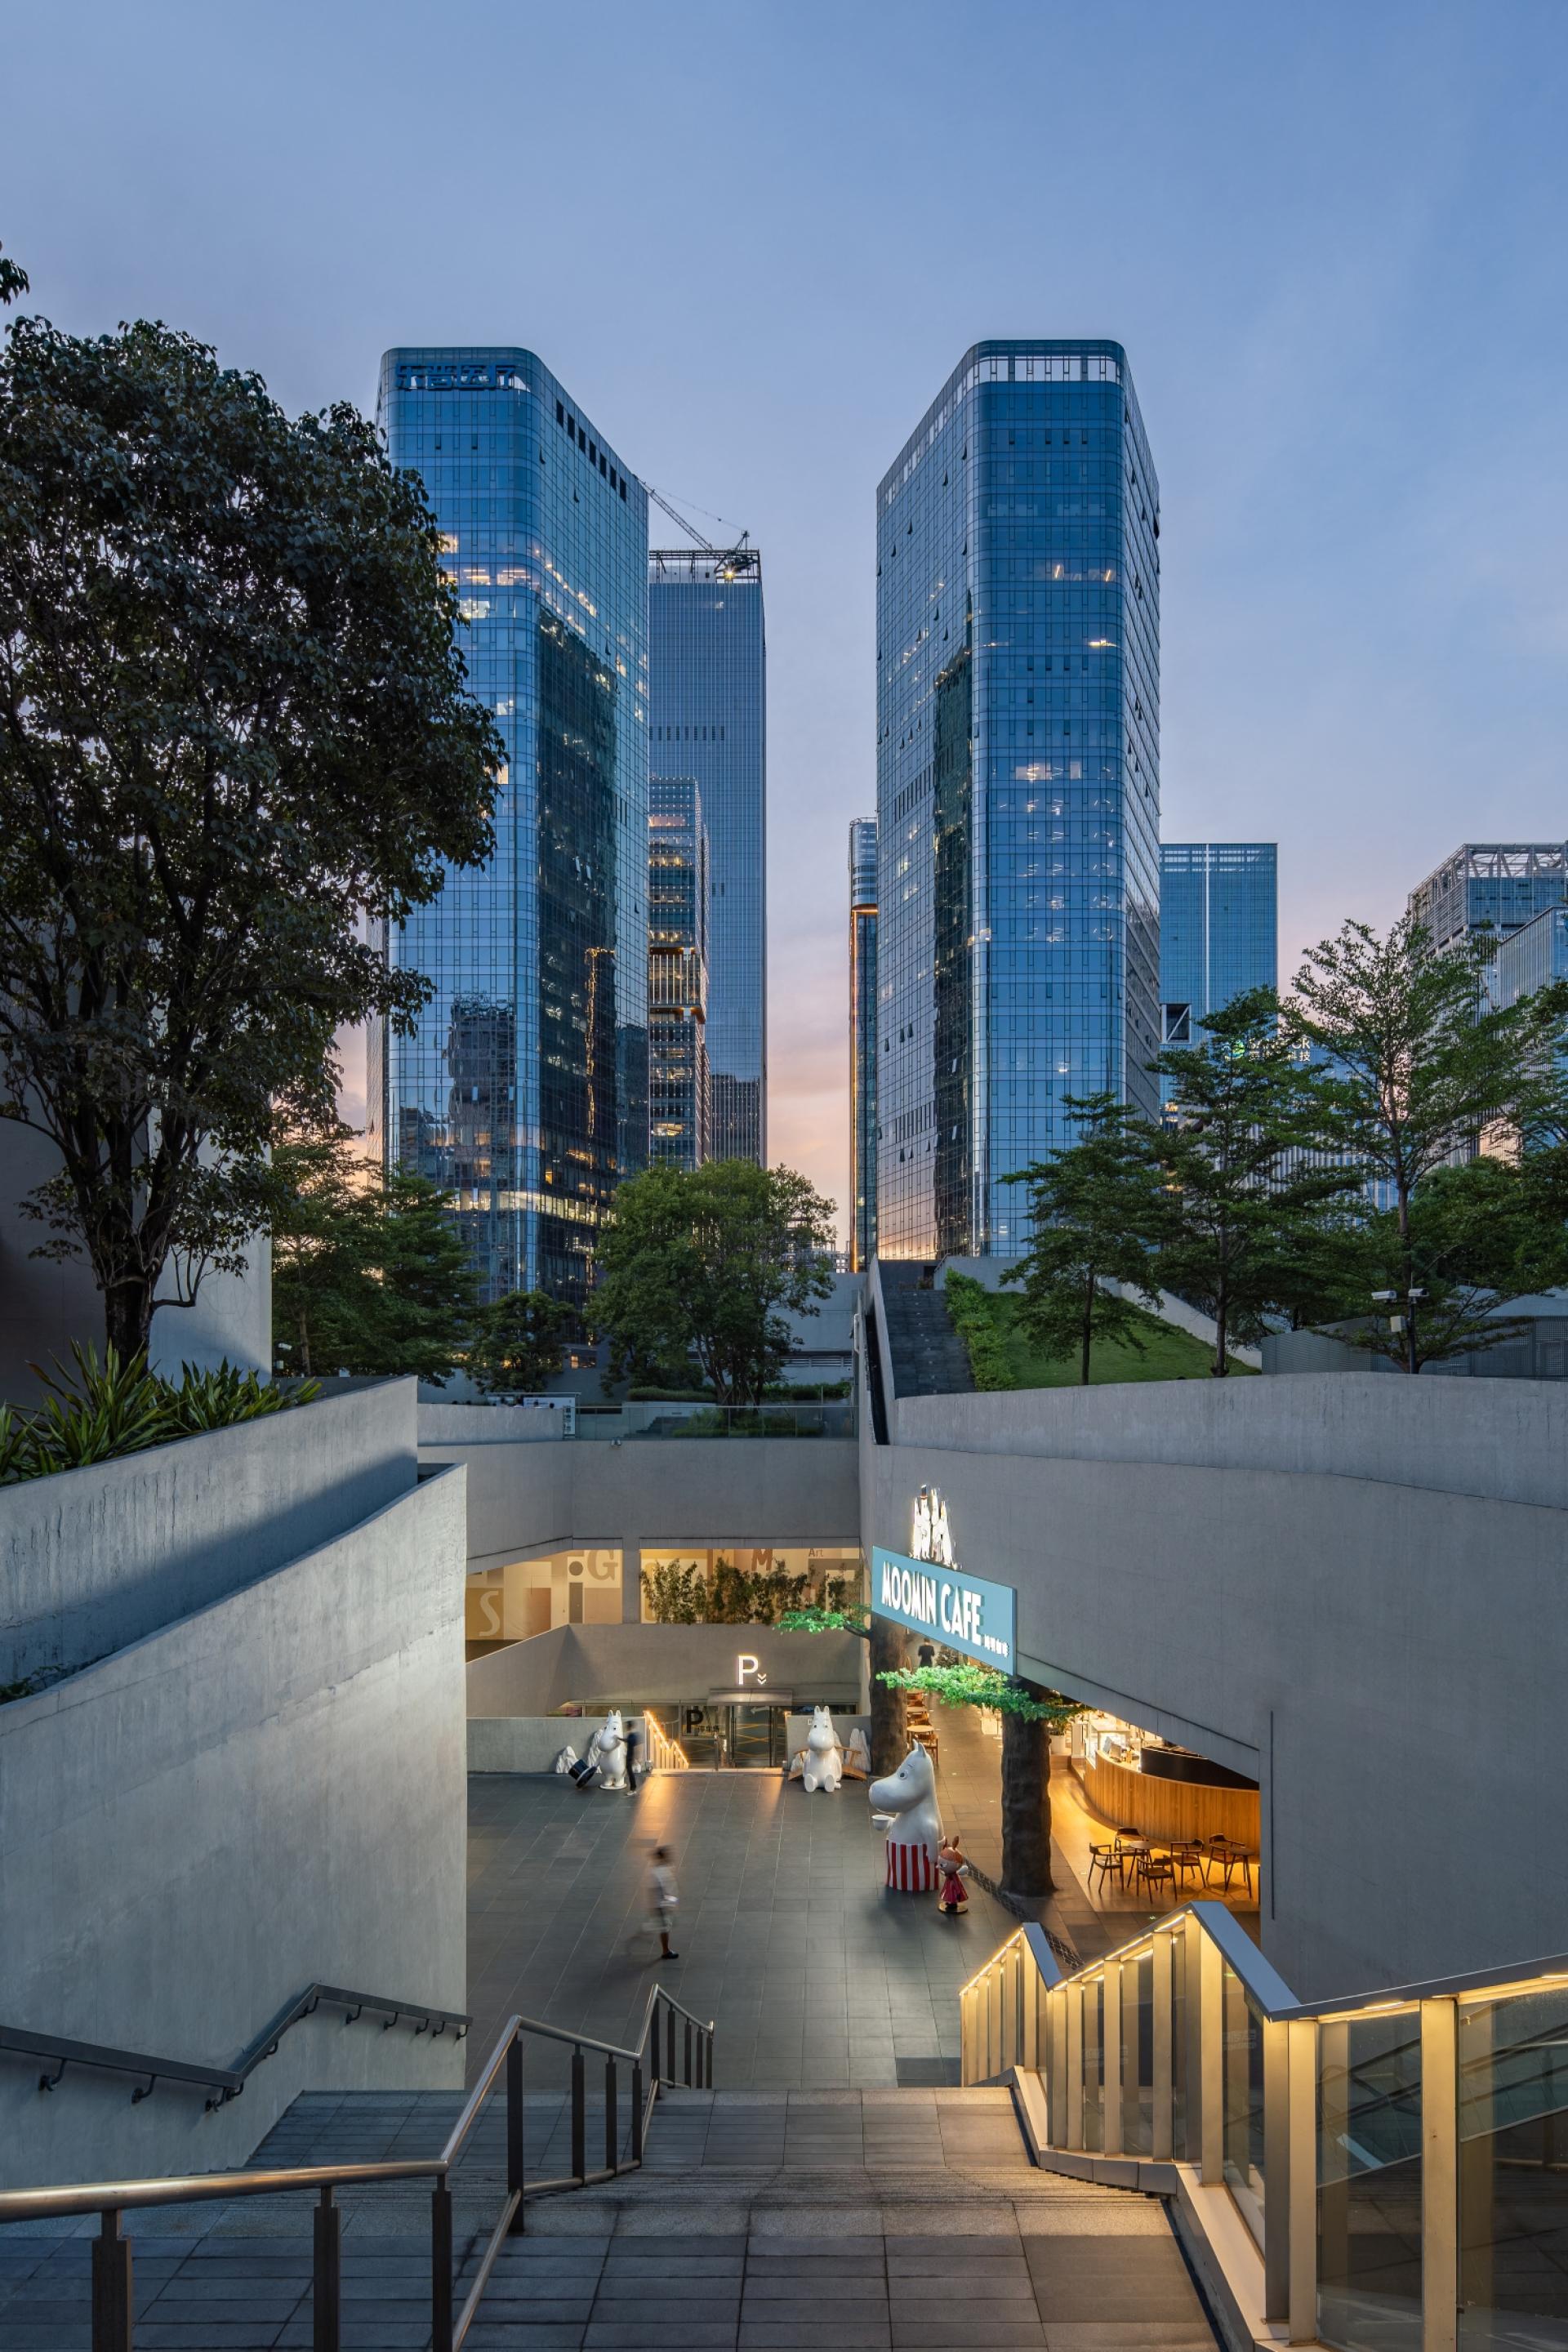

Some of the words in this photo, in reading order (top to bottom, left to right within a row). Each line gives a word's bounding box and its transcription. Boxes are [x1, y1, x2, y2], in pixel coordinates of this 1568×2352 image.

[882, 1561, 937, 1627] MOOMIN
[941, 1583, 982, 1646] CAFE
[738, 1655, 759, 1685] P
